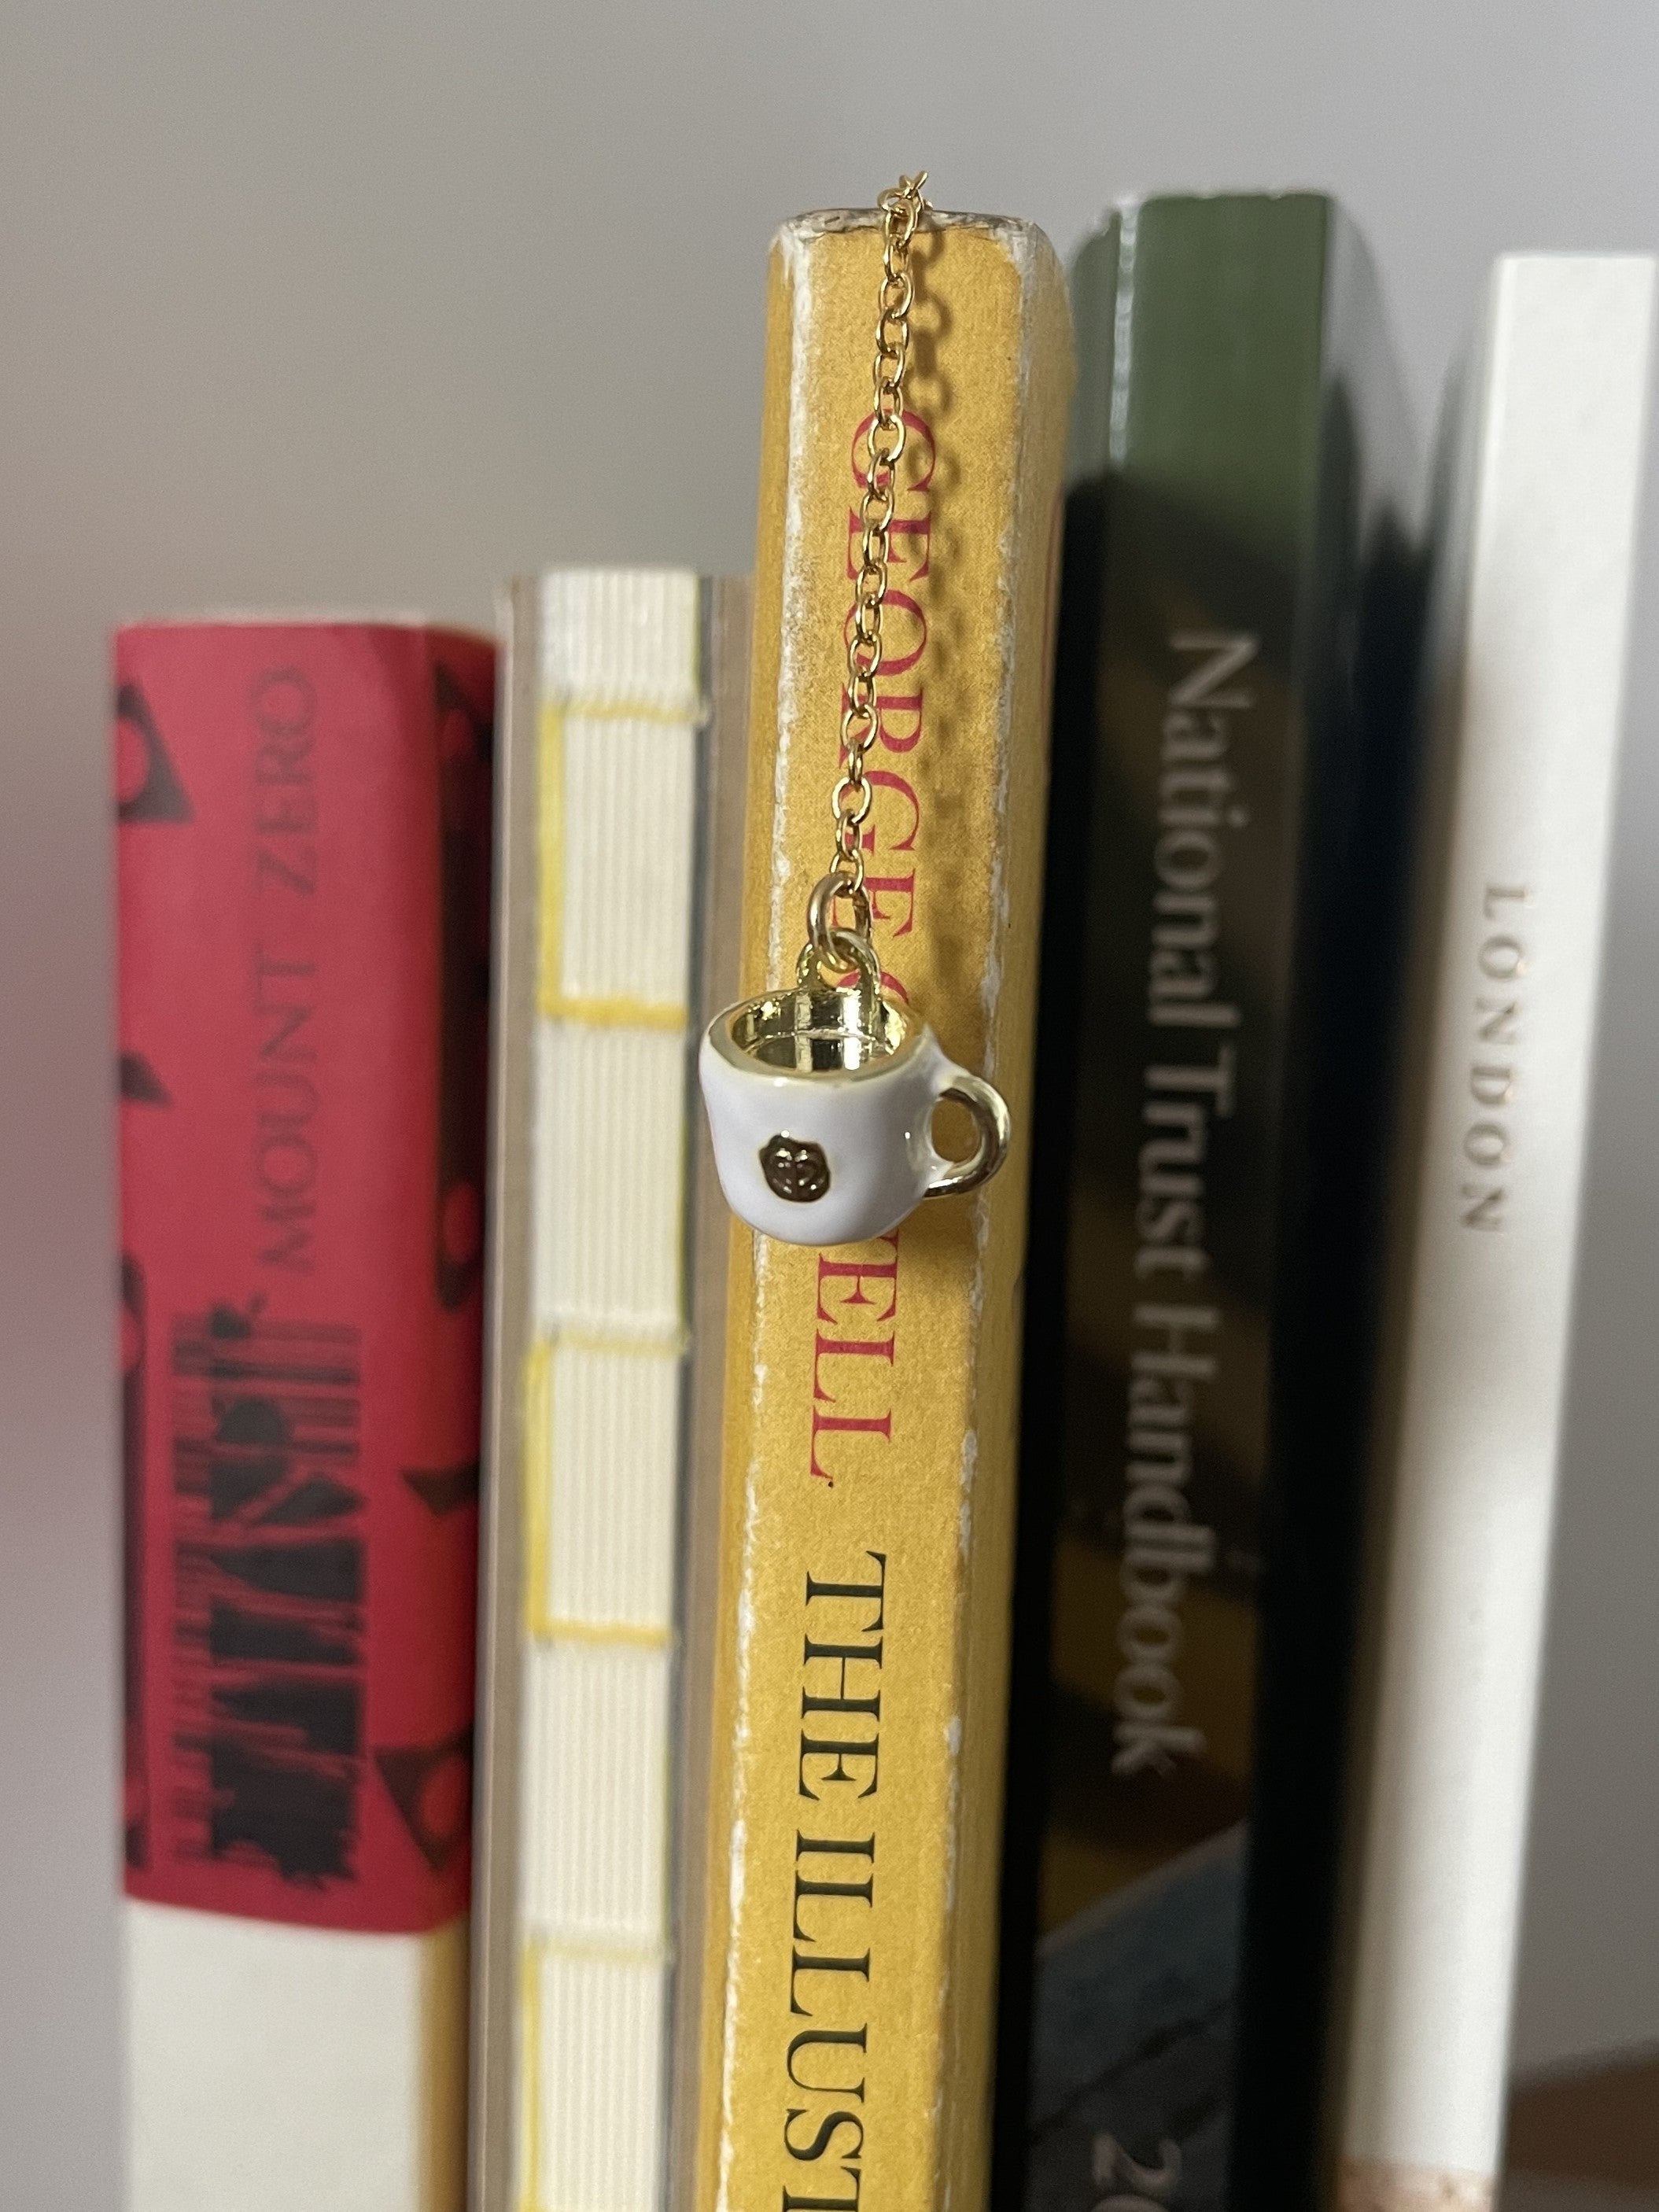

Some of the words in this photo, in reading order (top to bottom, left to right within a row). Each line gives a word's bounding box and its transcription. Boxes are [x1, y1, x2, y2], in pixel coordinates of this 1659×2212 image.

[249, 665, 319, 897] ZERO
[1146, 631, 1259, 1027] National
[250, 946, 319, 1274] MOUNT
[1134, 1041, 1237, 1280] Trust
[1461, 882, 1528, 1233] LONDON
[798, 1550, 887, 1801] THE
[1111, 1303, 1221, 1776] Handbook
